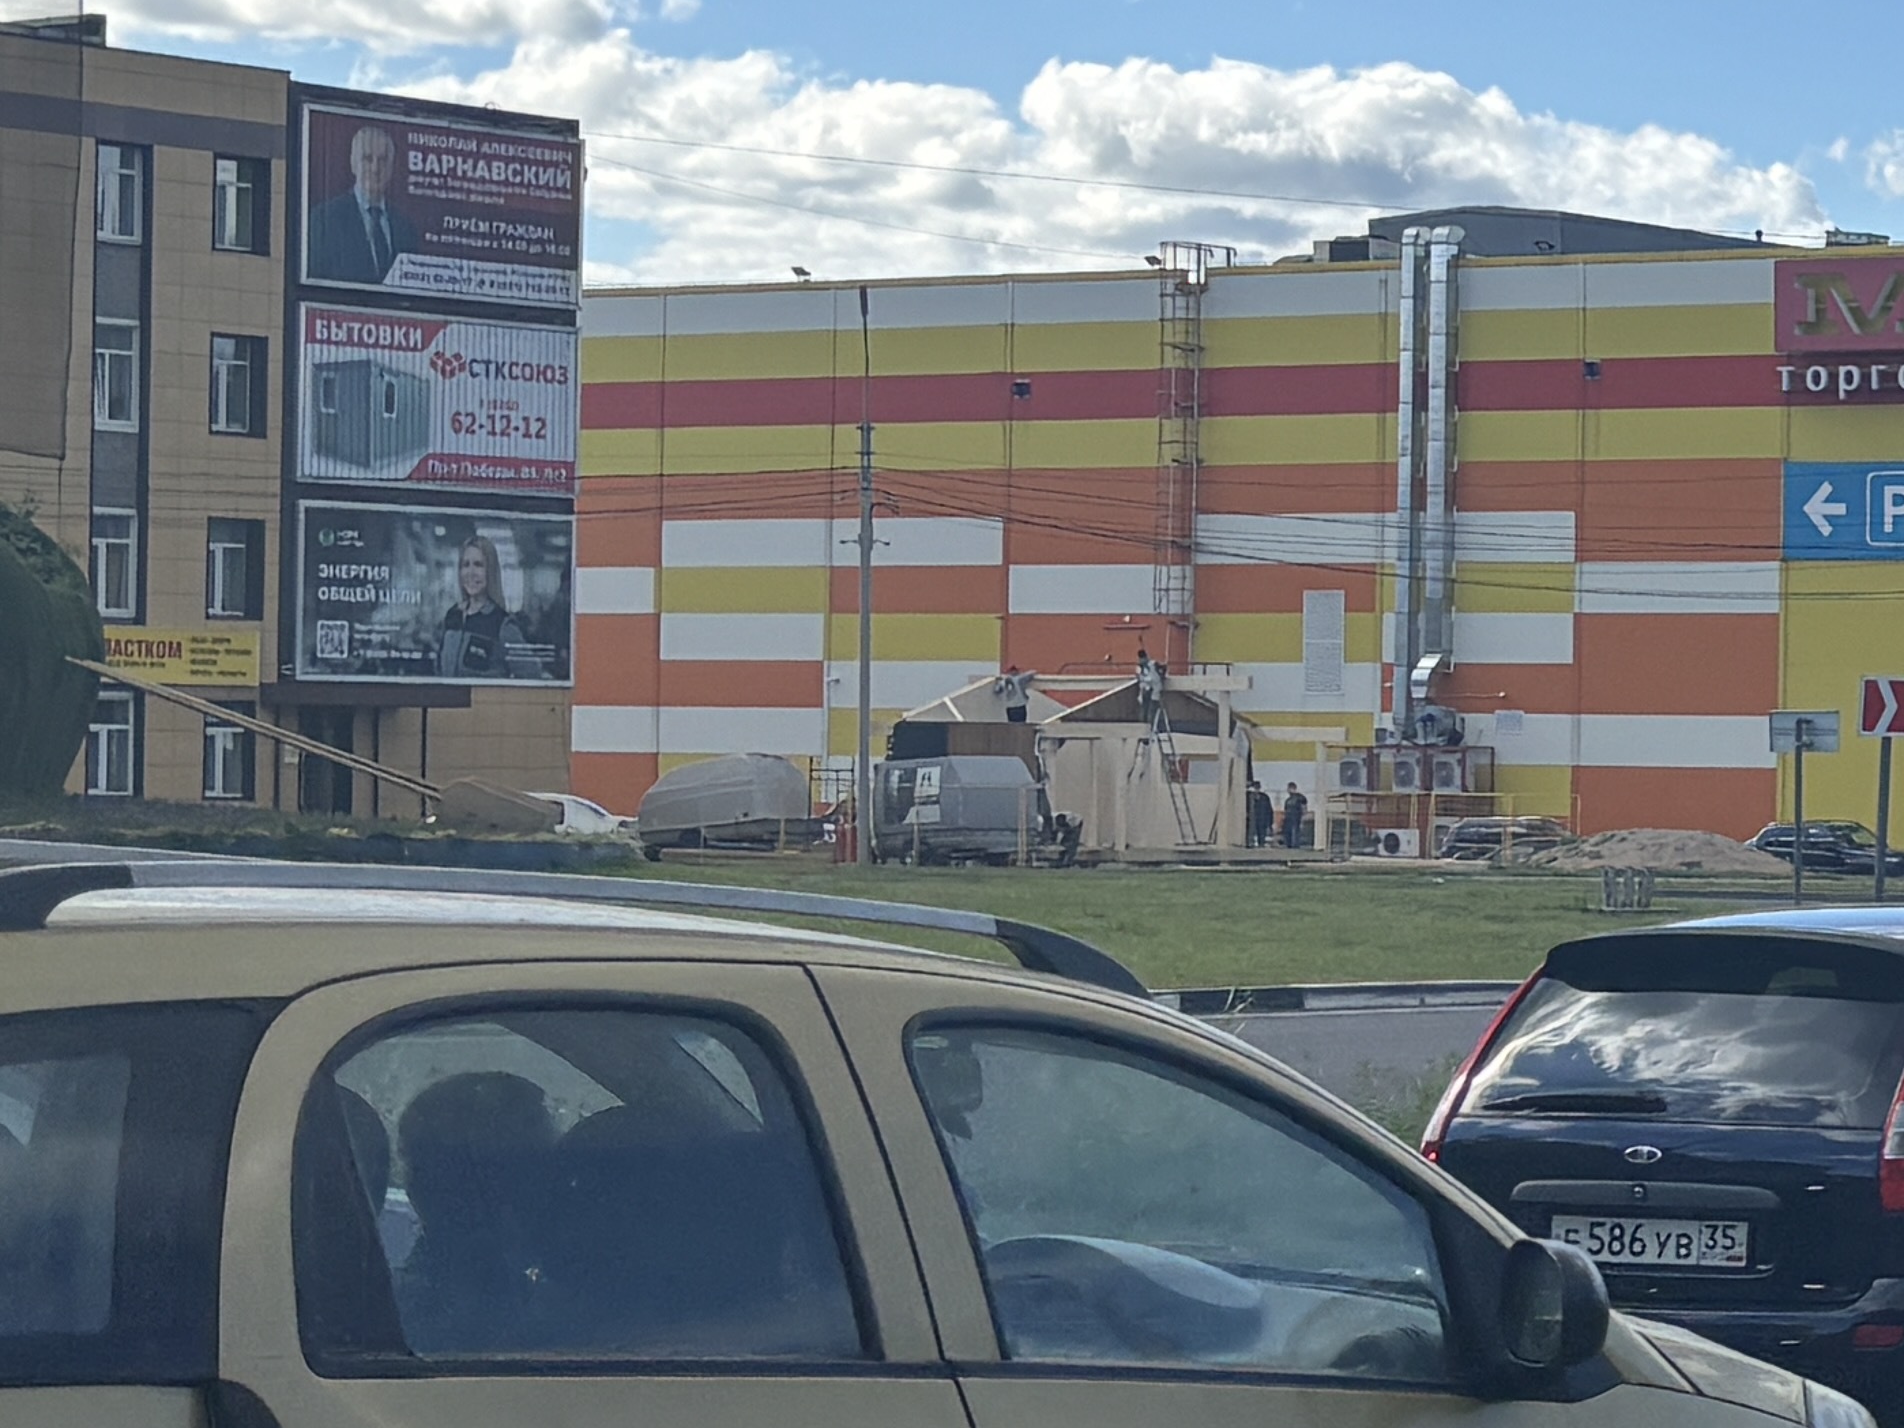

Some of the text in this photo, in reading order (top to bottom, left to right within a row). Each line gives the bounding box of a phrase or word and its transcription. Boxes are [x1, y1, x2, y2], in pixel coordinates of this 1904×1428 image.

[408, 150, 571, 189] ВАРНАВСКИЙ
[314, 318, 422, 349] БЫТОВКИ
[468, 359, 569, 385] СТКСОЮЗ
[450, 410, 548, 440] 62-12-12
[318, 563, 389, 581] ЭНЕРГИЯ
[318, 584, 376, 603] ОБЩЕЙ
[1704, 1224, 1738, 1251] 35
